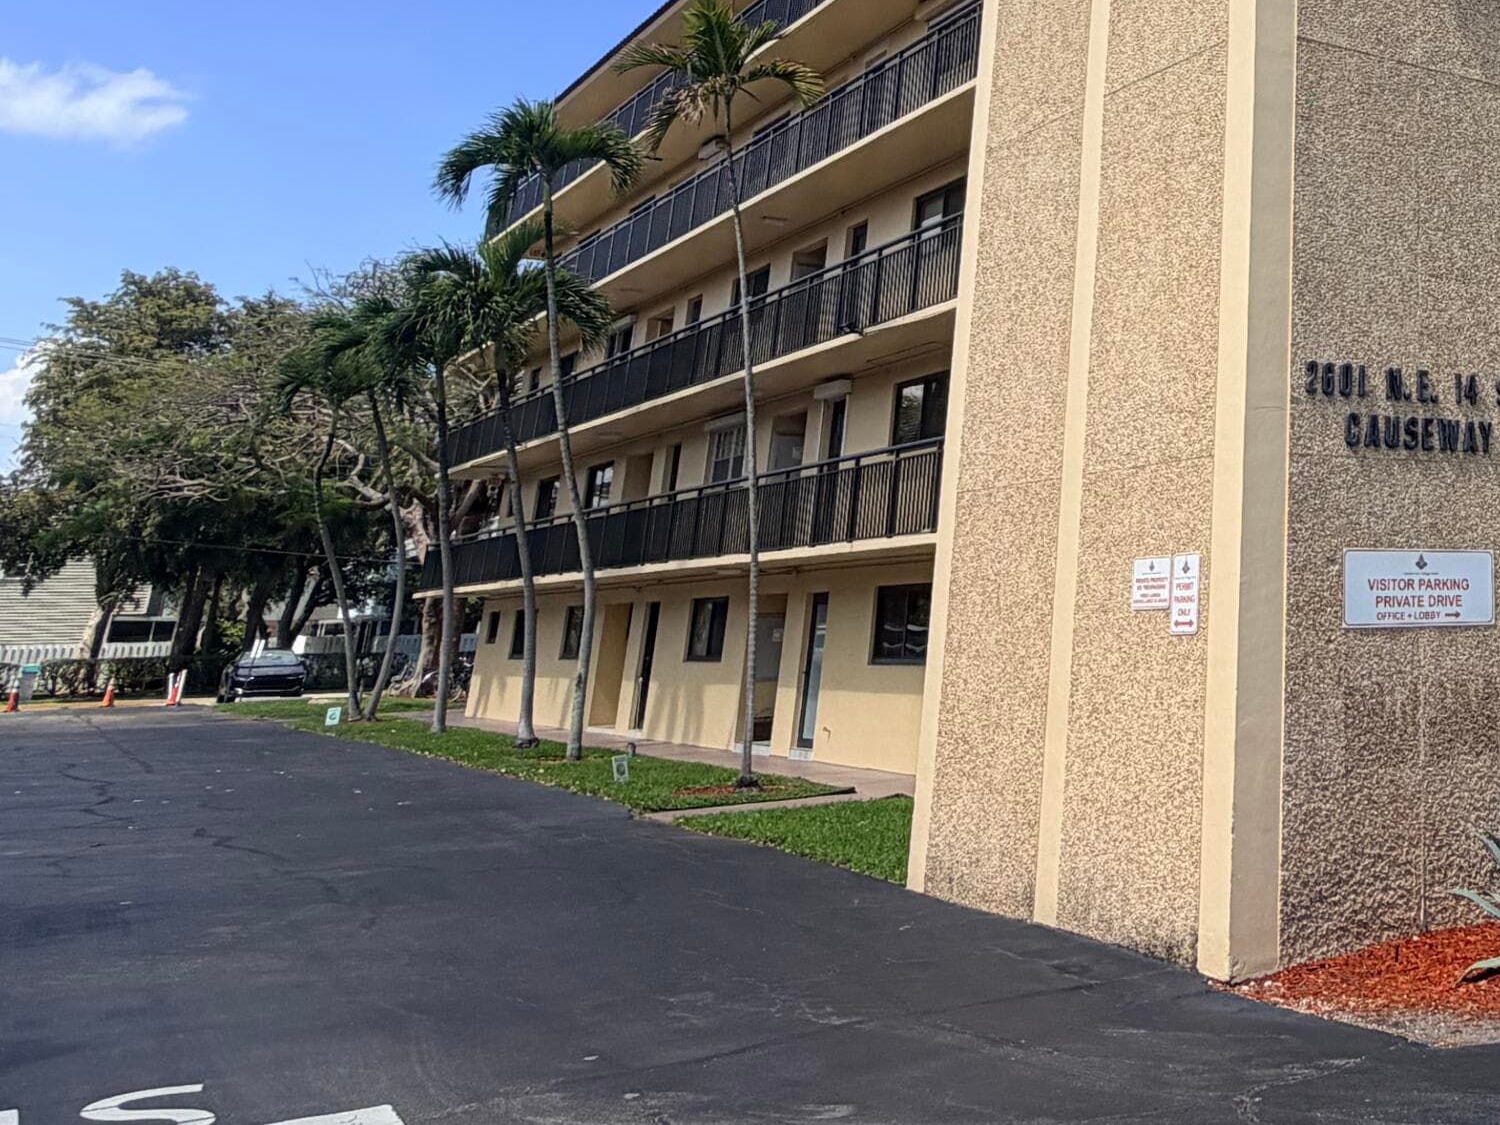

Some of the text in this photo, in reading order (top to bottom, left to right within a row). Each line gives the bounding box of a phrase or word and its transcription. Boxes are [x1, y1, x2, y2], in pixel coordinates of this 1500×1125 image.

[1304, 360, 1367, 398] 2601
[1386, 366, 1439, 404] N.E.
[1454, 373, 1479, 405] 14
[1344, 412, 1493, 454] CAUSEWAY
[1367, 578, 1470, 591] VISITOR PARKING
[1375, 594, 1463, 608] PRIVATE DRIVE
[1376, 611, 1406, 621] OFFICE
[1414, 611, 1441, 620] LOBBY
